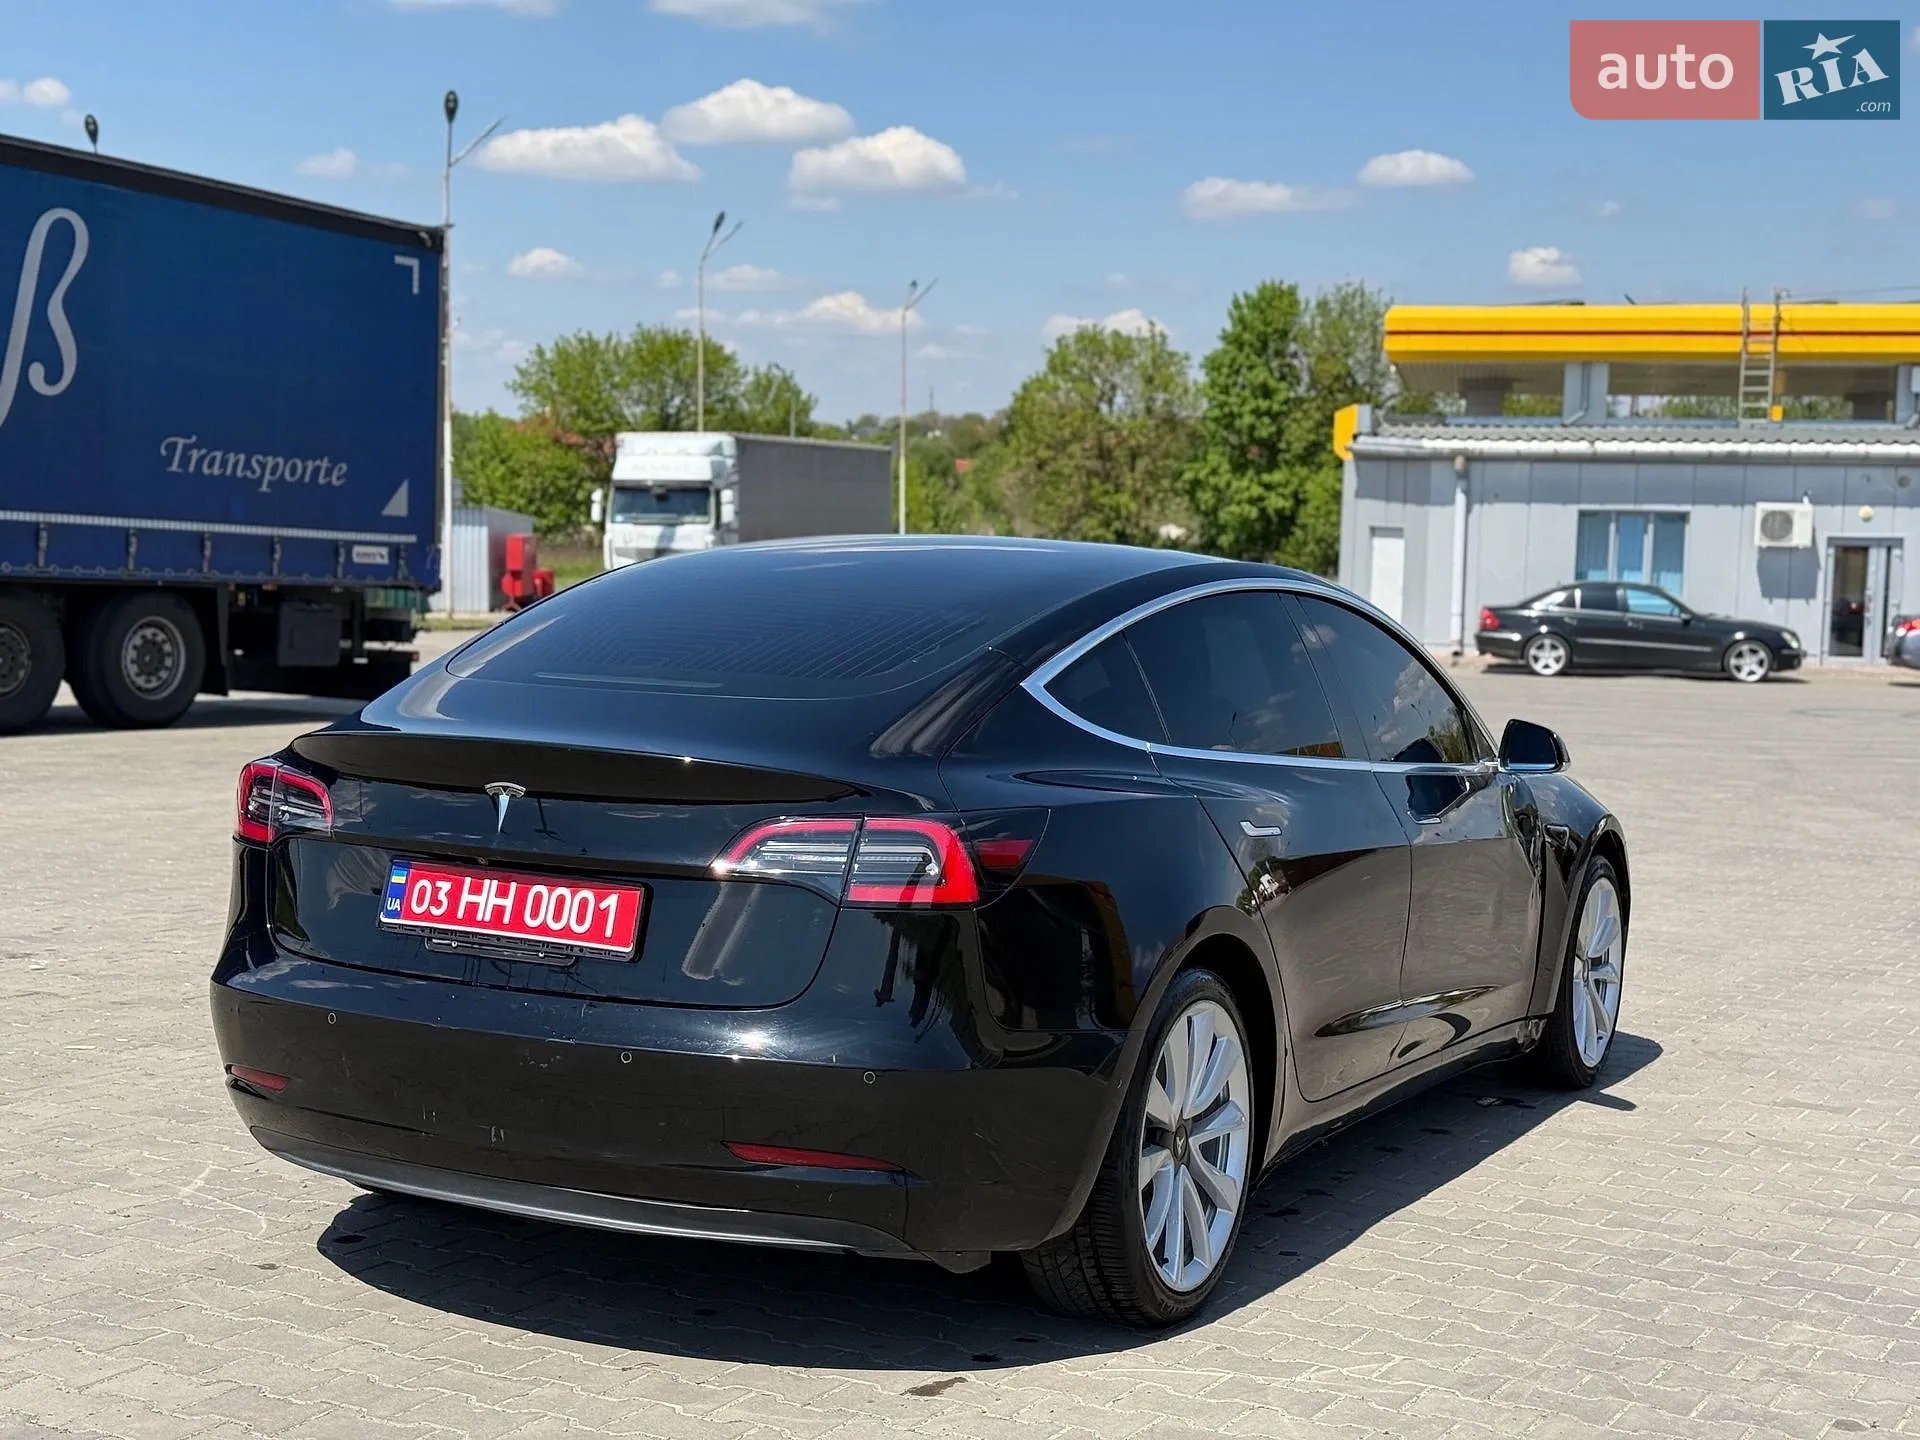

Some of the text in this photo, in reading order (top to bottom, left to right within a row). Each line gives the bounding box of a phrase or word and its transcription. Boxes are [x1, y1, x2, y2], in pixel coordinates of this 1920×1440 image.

[160, 435, 348, 493] Transporte
[386, 897, 401, 912] UA
[411, 877, 619, 938] 03 HH 0001
